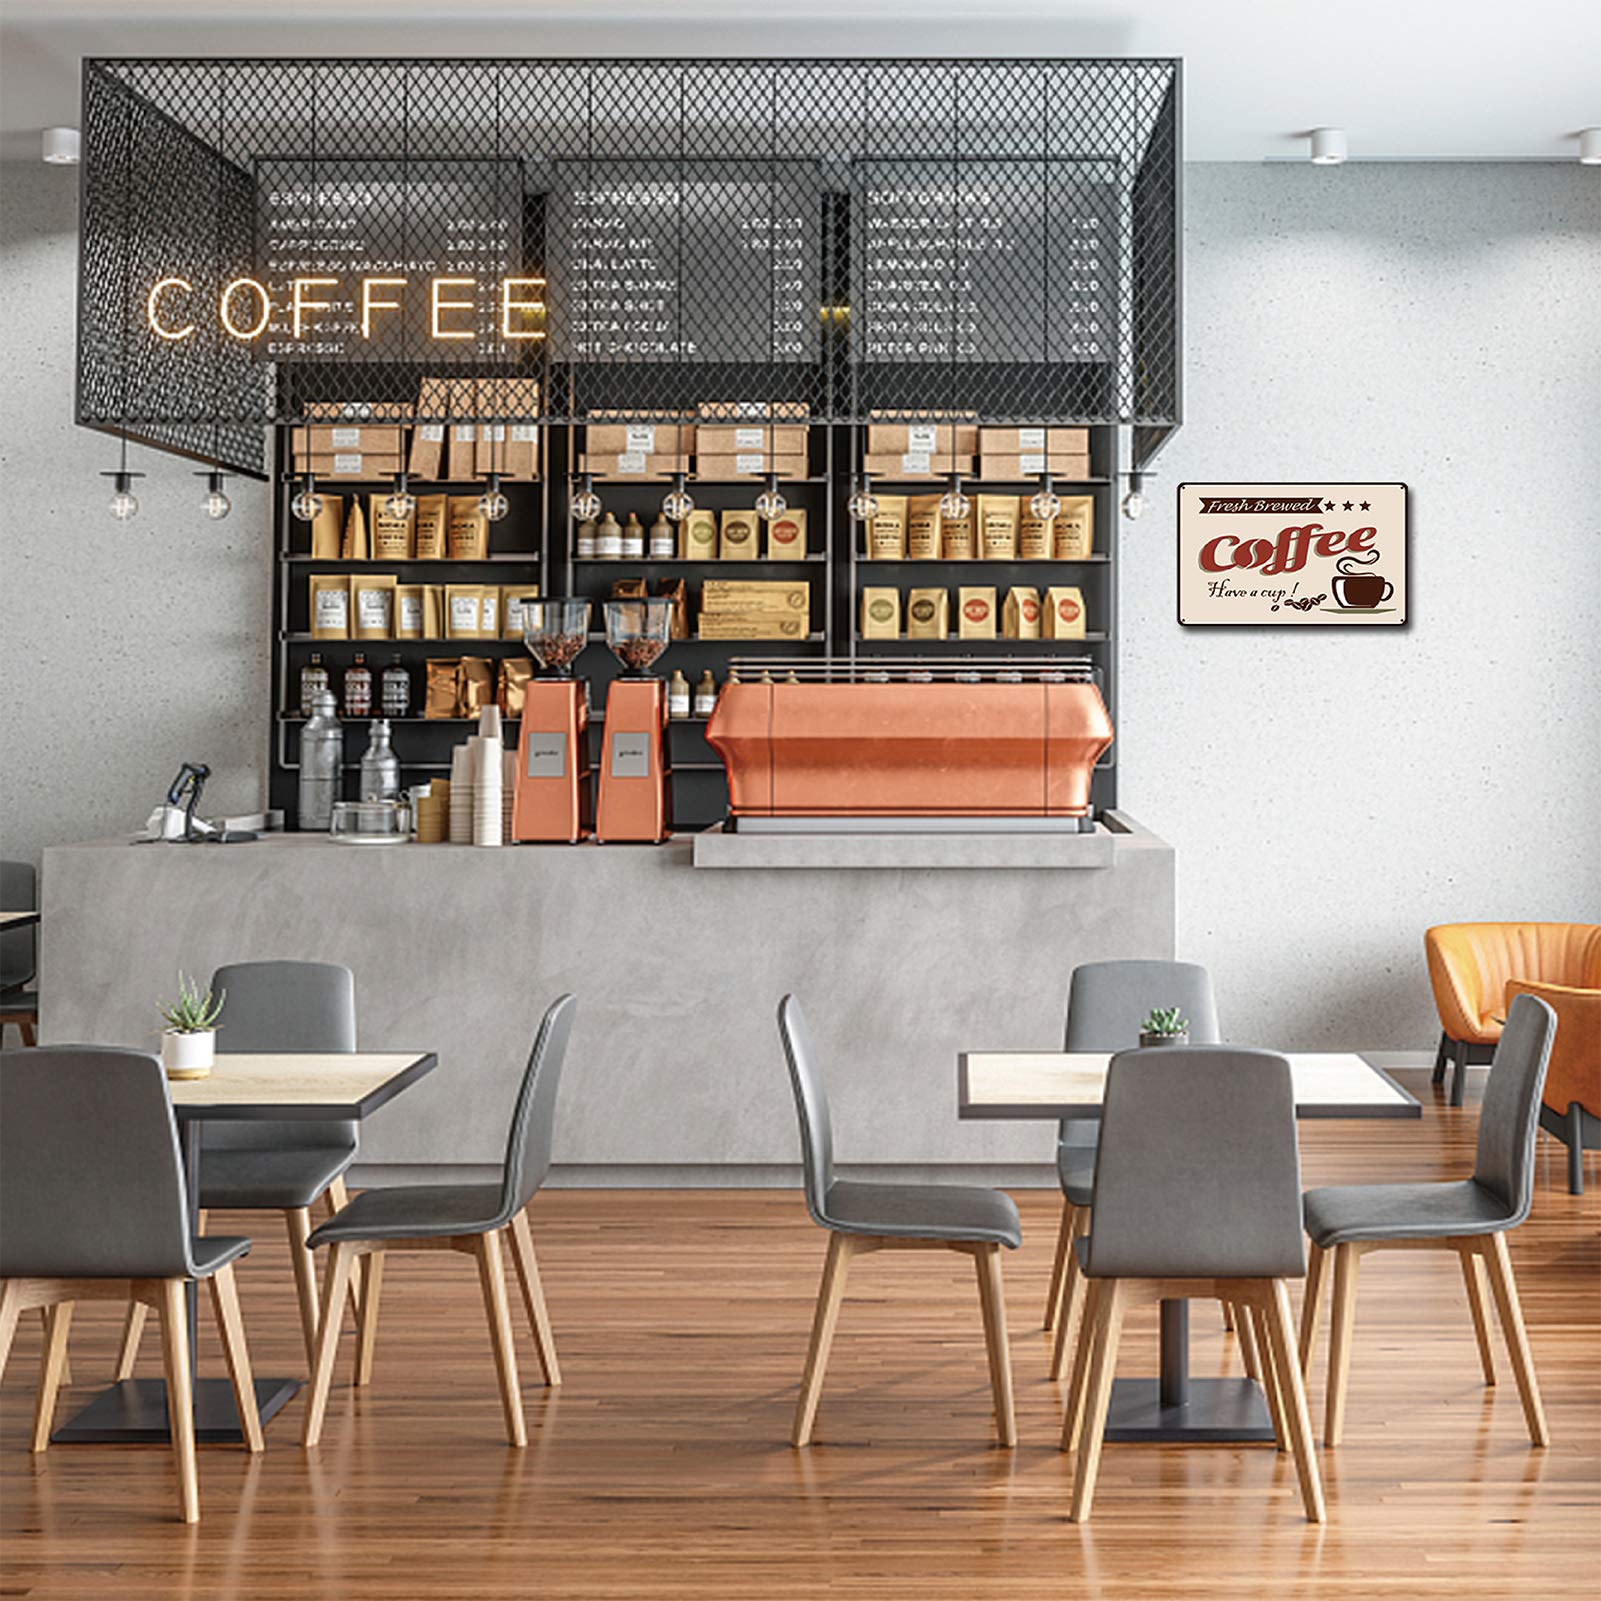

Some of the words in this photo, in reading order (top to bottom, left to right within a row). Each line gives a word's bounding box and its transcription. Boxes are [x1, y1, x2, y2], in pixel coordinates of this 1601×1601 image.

[147, 276, 547, 340] COFFEE
[1207, 499, 1252, 514] Fresh
[1253, 499, 1317, 513] Brewed
[1198, 522, 1378, 576] Coffee
[1207, 578, 1248, 598] Have
[1249, 588, 1257, 598] a
